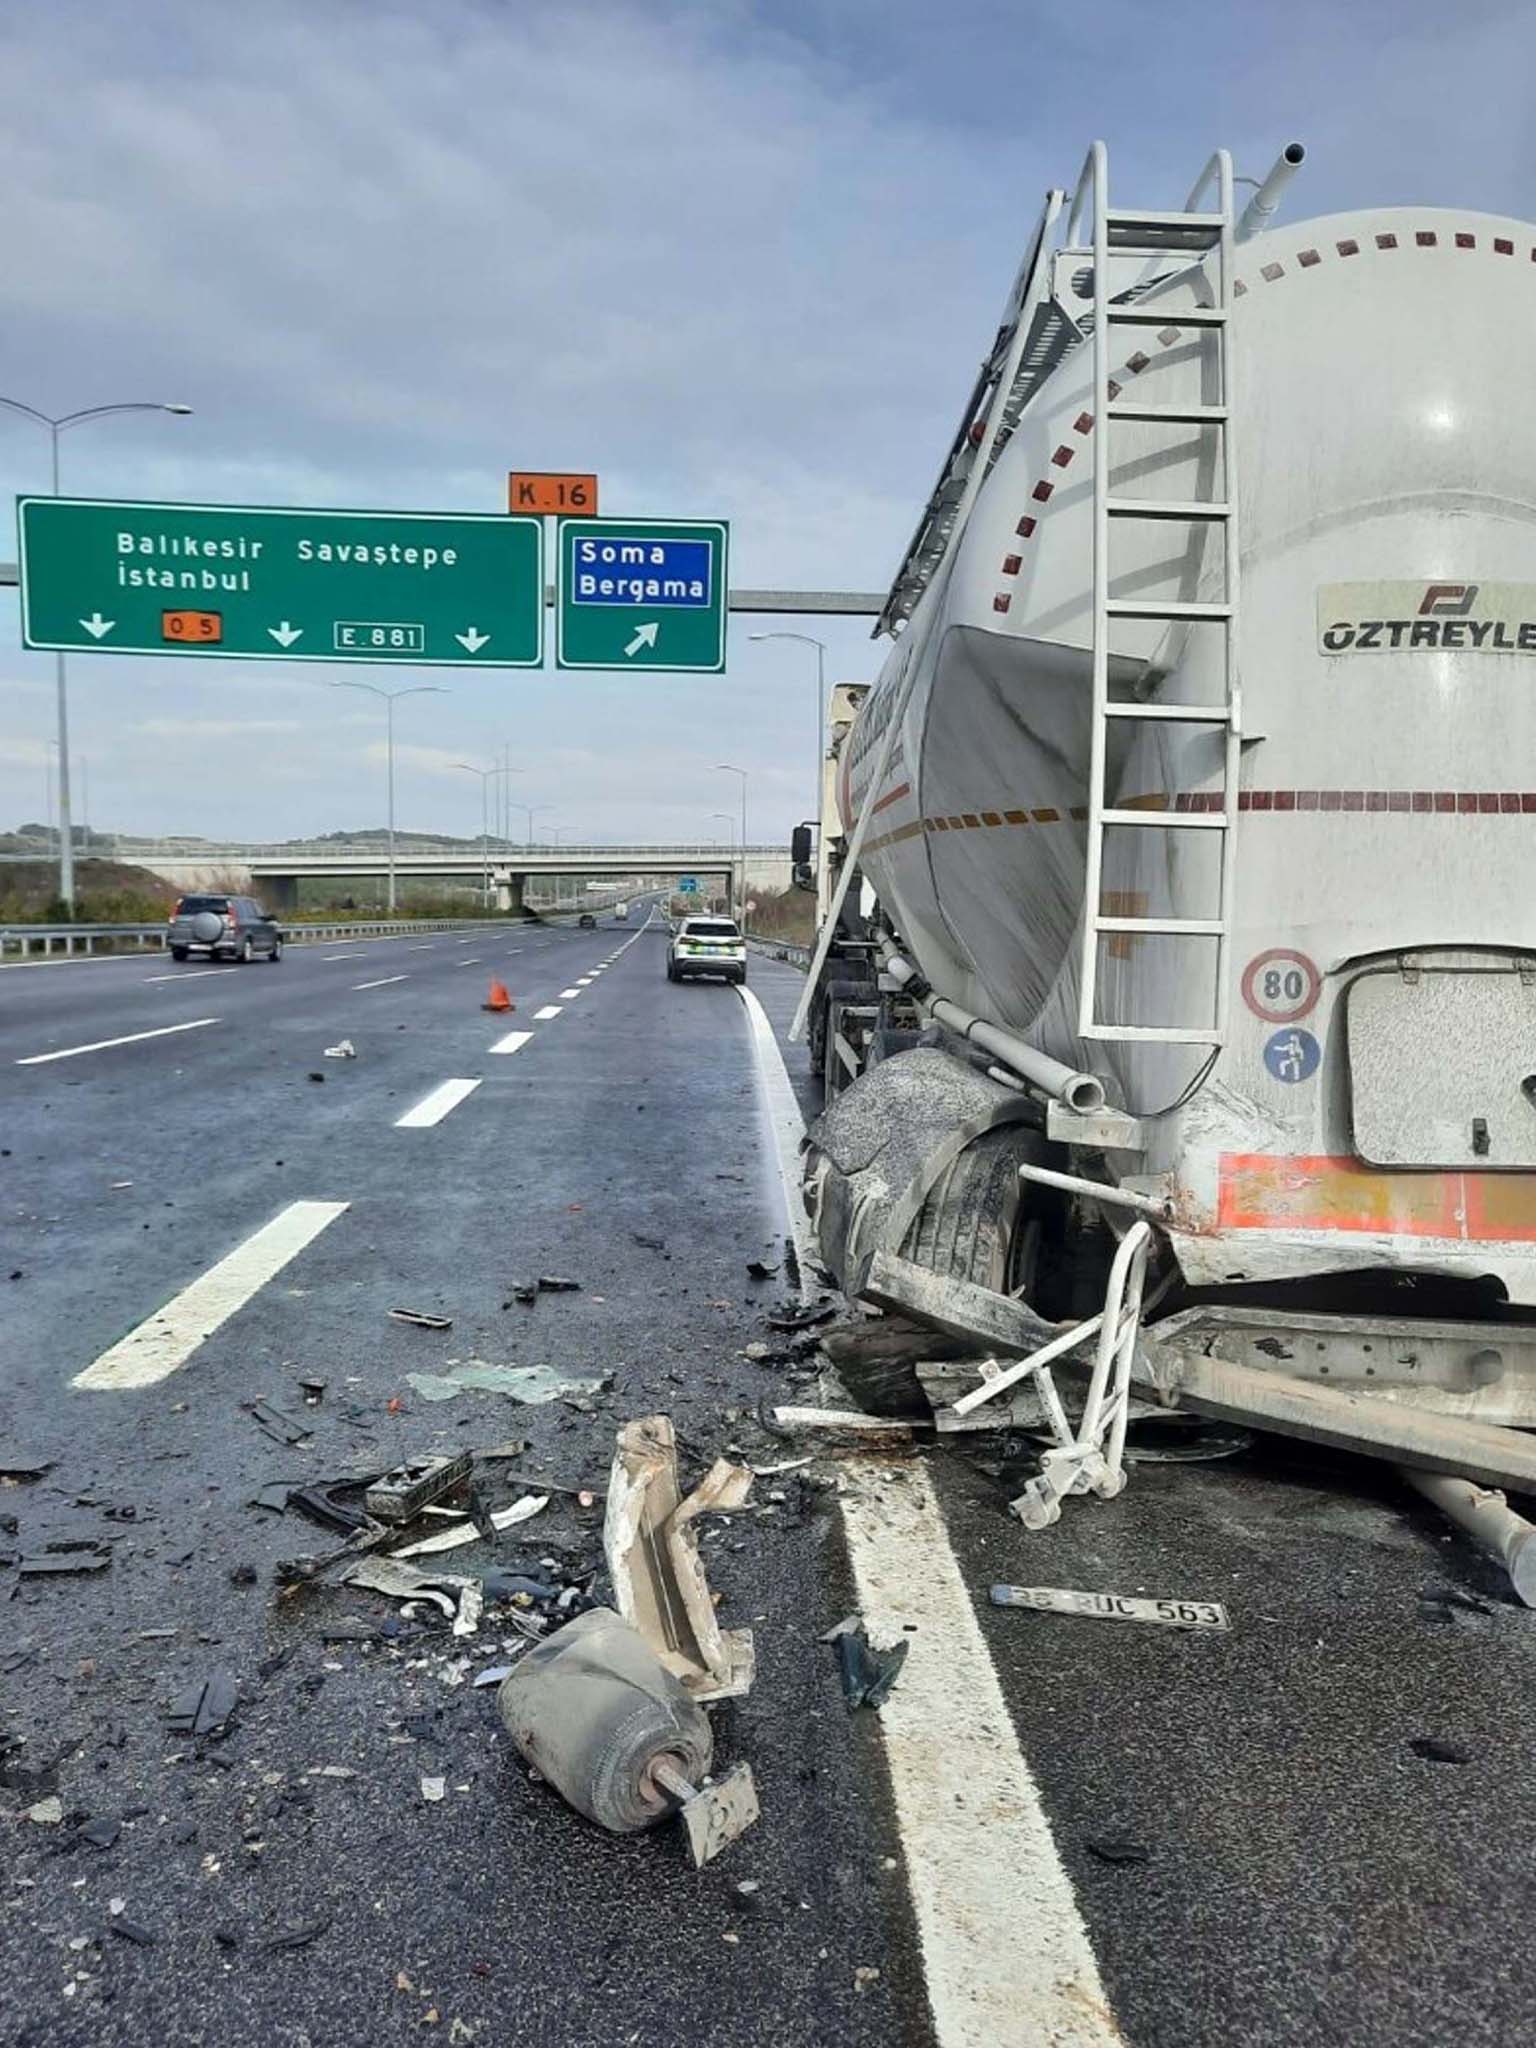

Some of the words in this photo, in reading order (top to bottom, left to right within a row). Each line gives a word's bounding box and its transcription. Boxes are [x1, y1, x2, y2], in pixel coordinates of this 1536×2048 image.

[117, 532, 263, 559] Balıkesir
[298, 540, 457, 570] Savaştepe
[581, 542, 665, 564] Soma
[118, 560, 249, 591] İstanbul
[580, 574, 703, 602] Bergama
[1264, 970, 1303, 999] 80
[1157, 1601, 1219, 1624] 563
